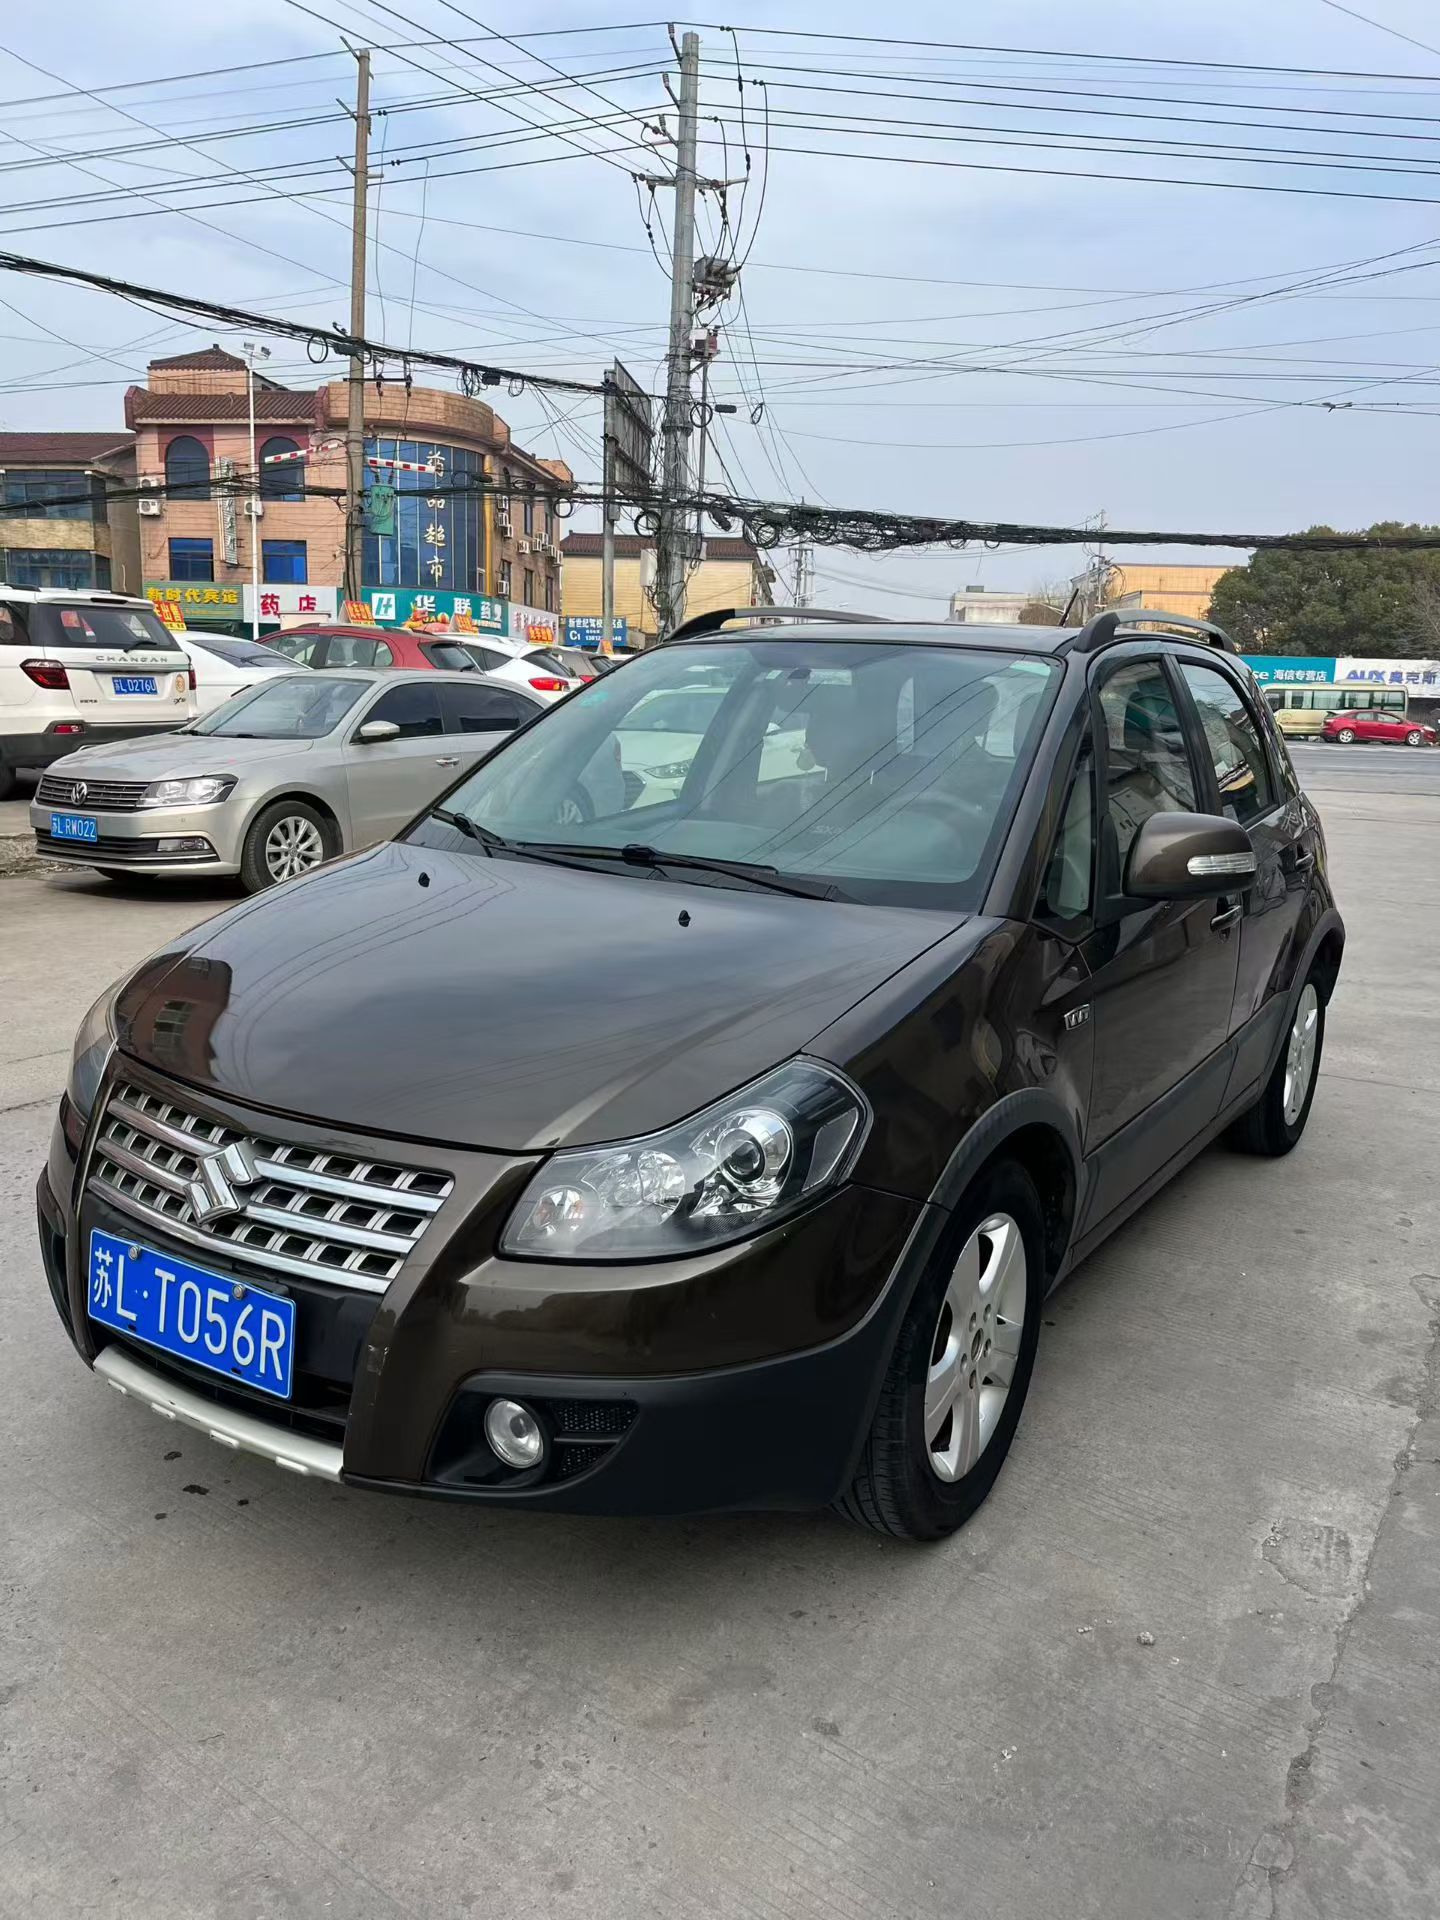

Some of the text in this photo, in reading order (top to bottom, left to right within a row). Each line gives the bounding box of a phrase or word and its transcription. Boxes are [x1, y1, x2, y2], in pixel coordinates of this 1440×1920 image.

[147, 587, 238, 604] 新时代宾馆
[260, 593, 317, 616] 药店
[568, 618, 623, 629] 新世纪驾校名点
[95, 655, 168, 663] CHANGAN
[1273, 669, 1328, 682] 海信专营店
[1346, 670, 1387, 683] AUX
[1388, 671, 1438, 685] 奥克斯
